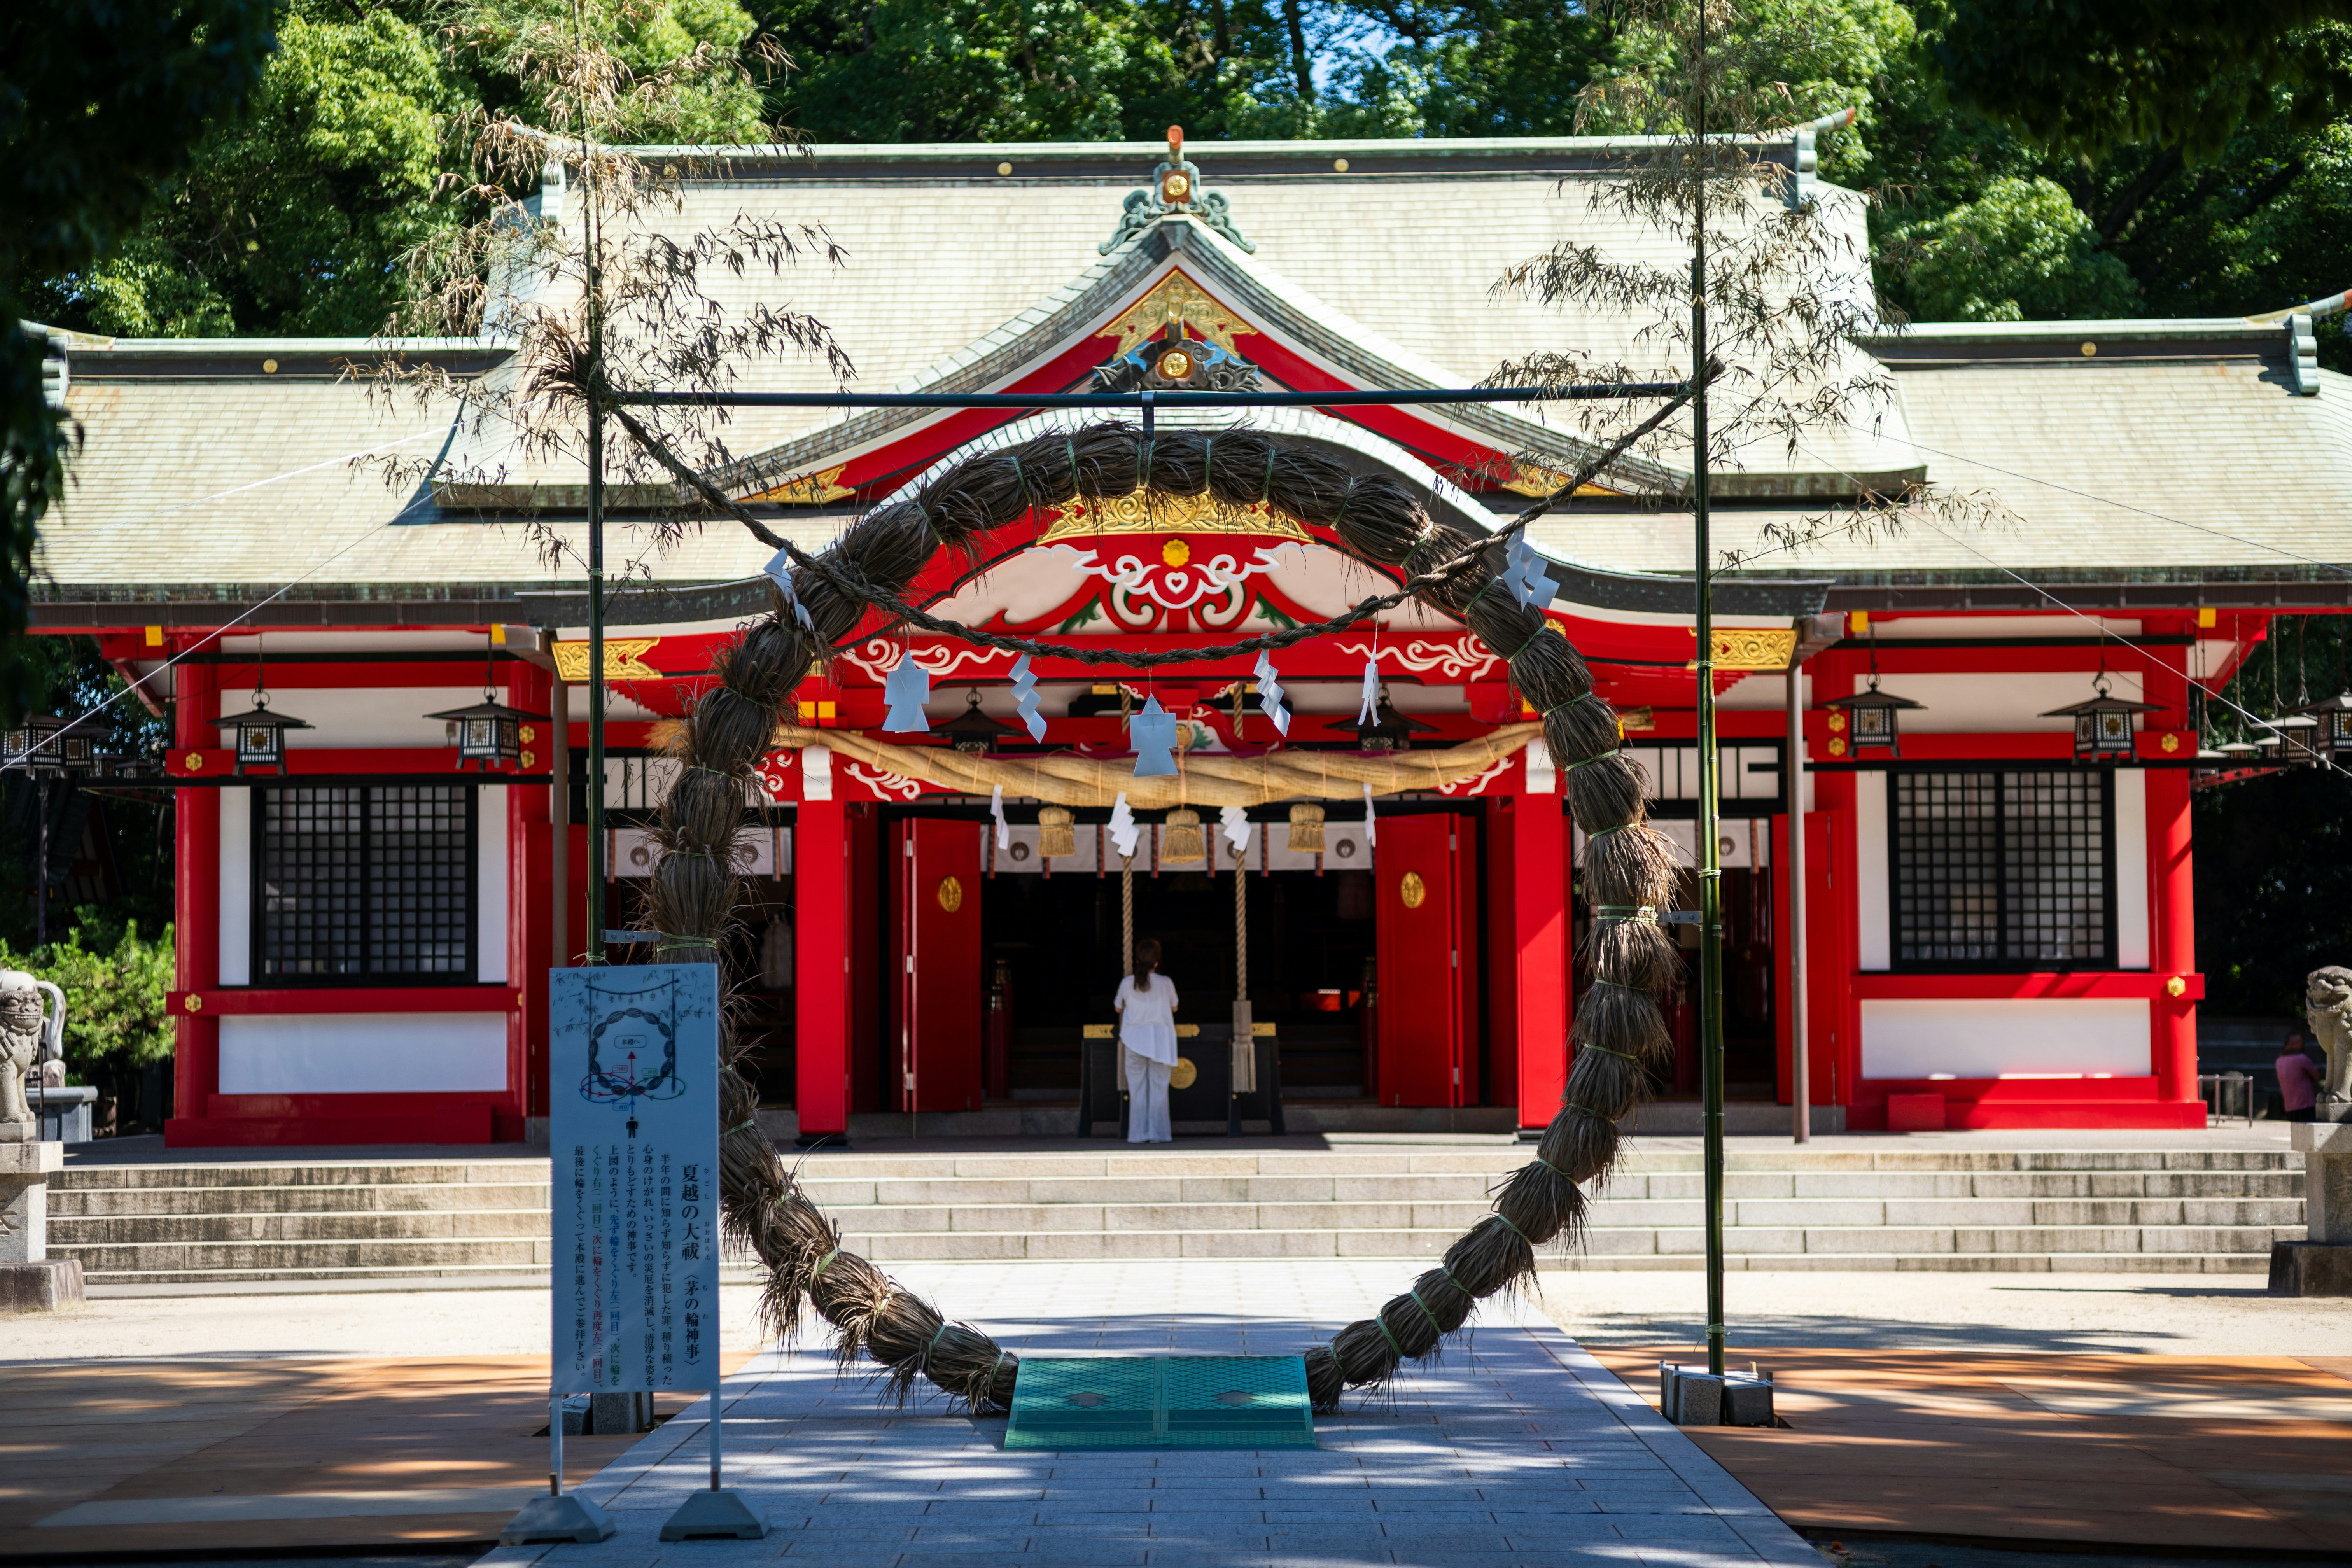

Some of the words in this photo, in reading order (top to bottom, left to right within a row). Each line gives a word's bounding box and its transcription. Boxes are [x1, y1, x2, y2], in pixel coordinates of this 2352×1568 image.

[574, 1146, 585, 1377] 最後に輪をくぐって本殿に進んでご参拝下さい。
[626, 1144, 637, 1278] とりもどすための神事です。
[643, 1144, 655, 1386] 心身のけがれ、いっさいの災厄を消滅し、清浄な姿を
[660, 1154, 672, 1385] 半年の間に知らず知らずに犯した罪、積り積った
